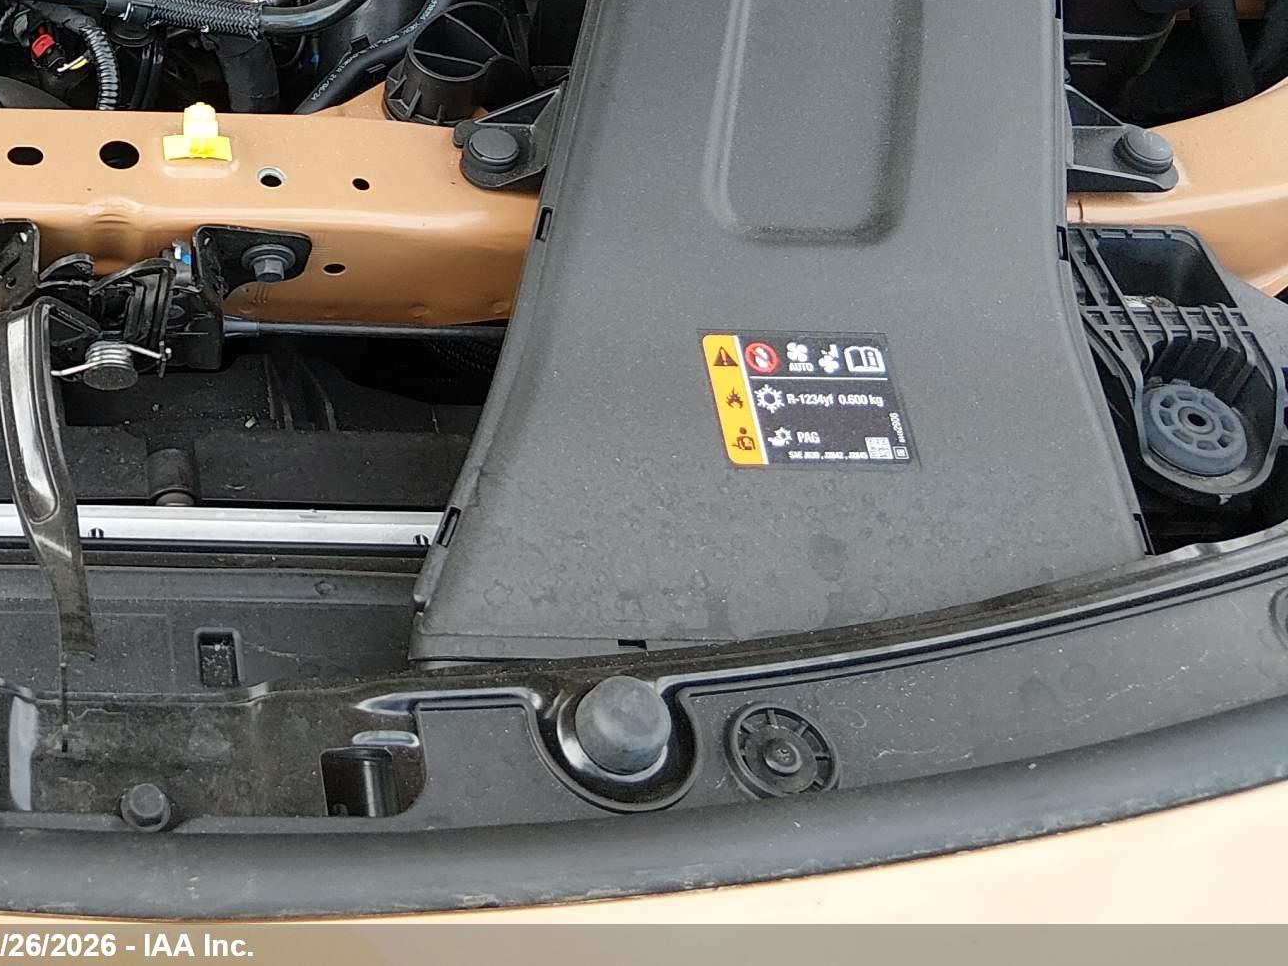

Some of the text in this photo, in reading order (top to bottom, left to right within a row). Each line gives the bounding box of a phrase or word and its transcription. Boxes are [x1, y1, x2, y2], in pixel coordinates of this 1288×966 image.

[789, 362, 814, 372] AUTO
[786, 393, 834, 408] R-1234yf
[868, 394, 884, 408] kg
[797, 432, 821, 444] PAG
